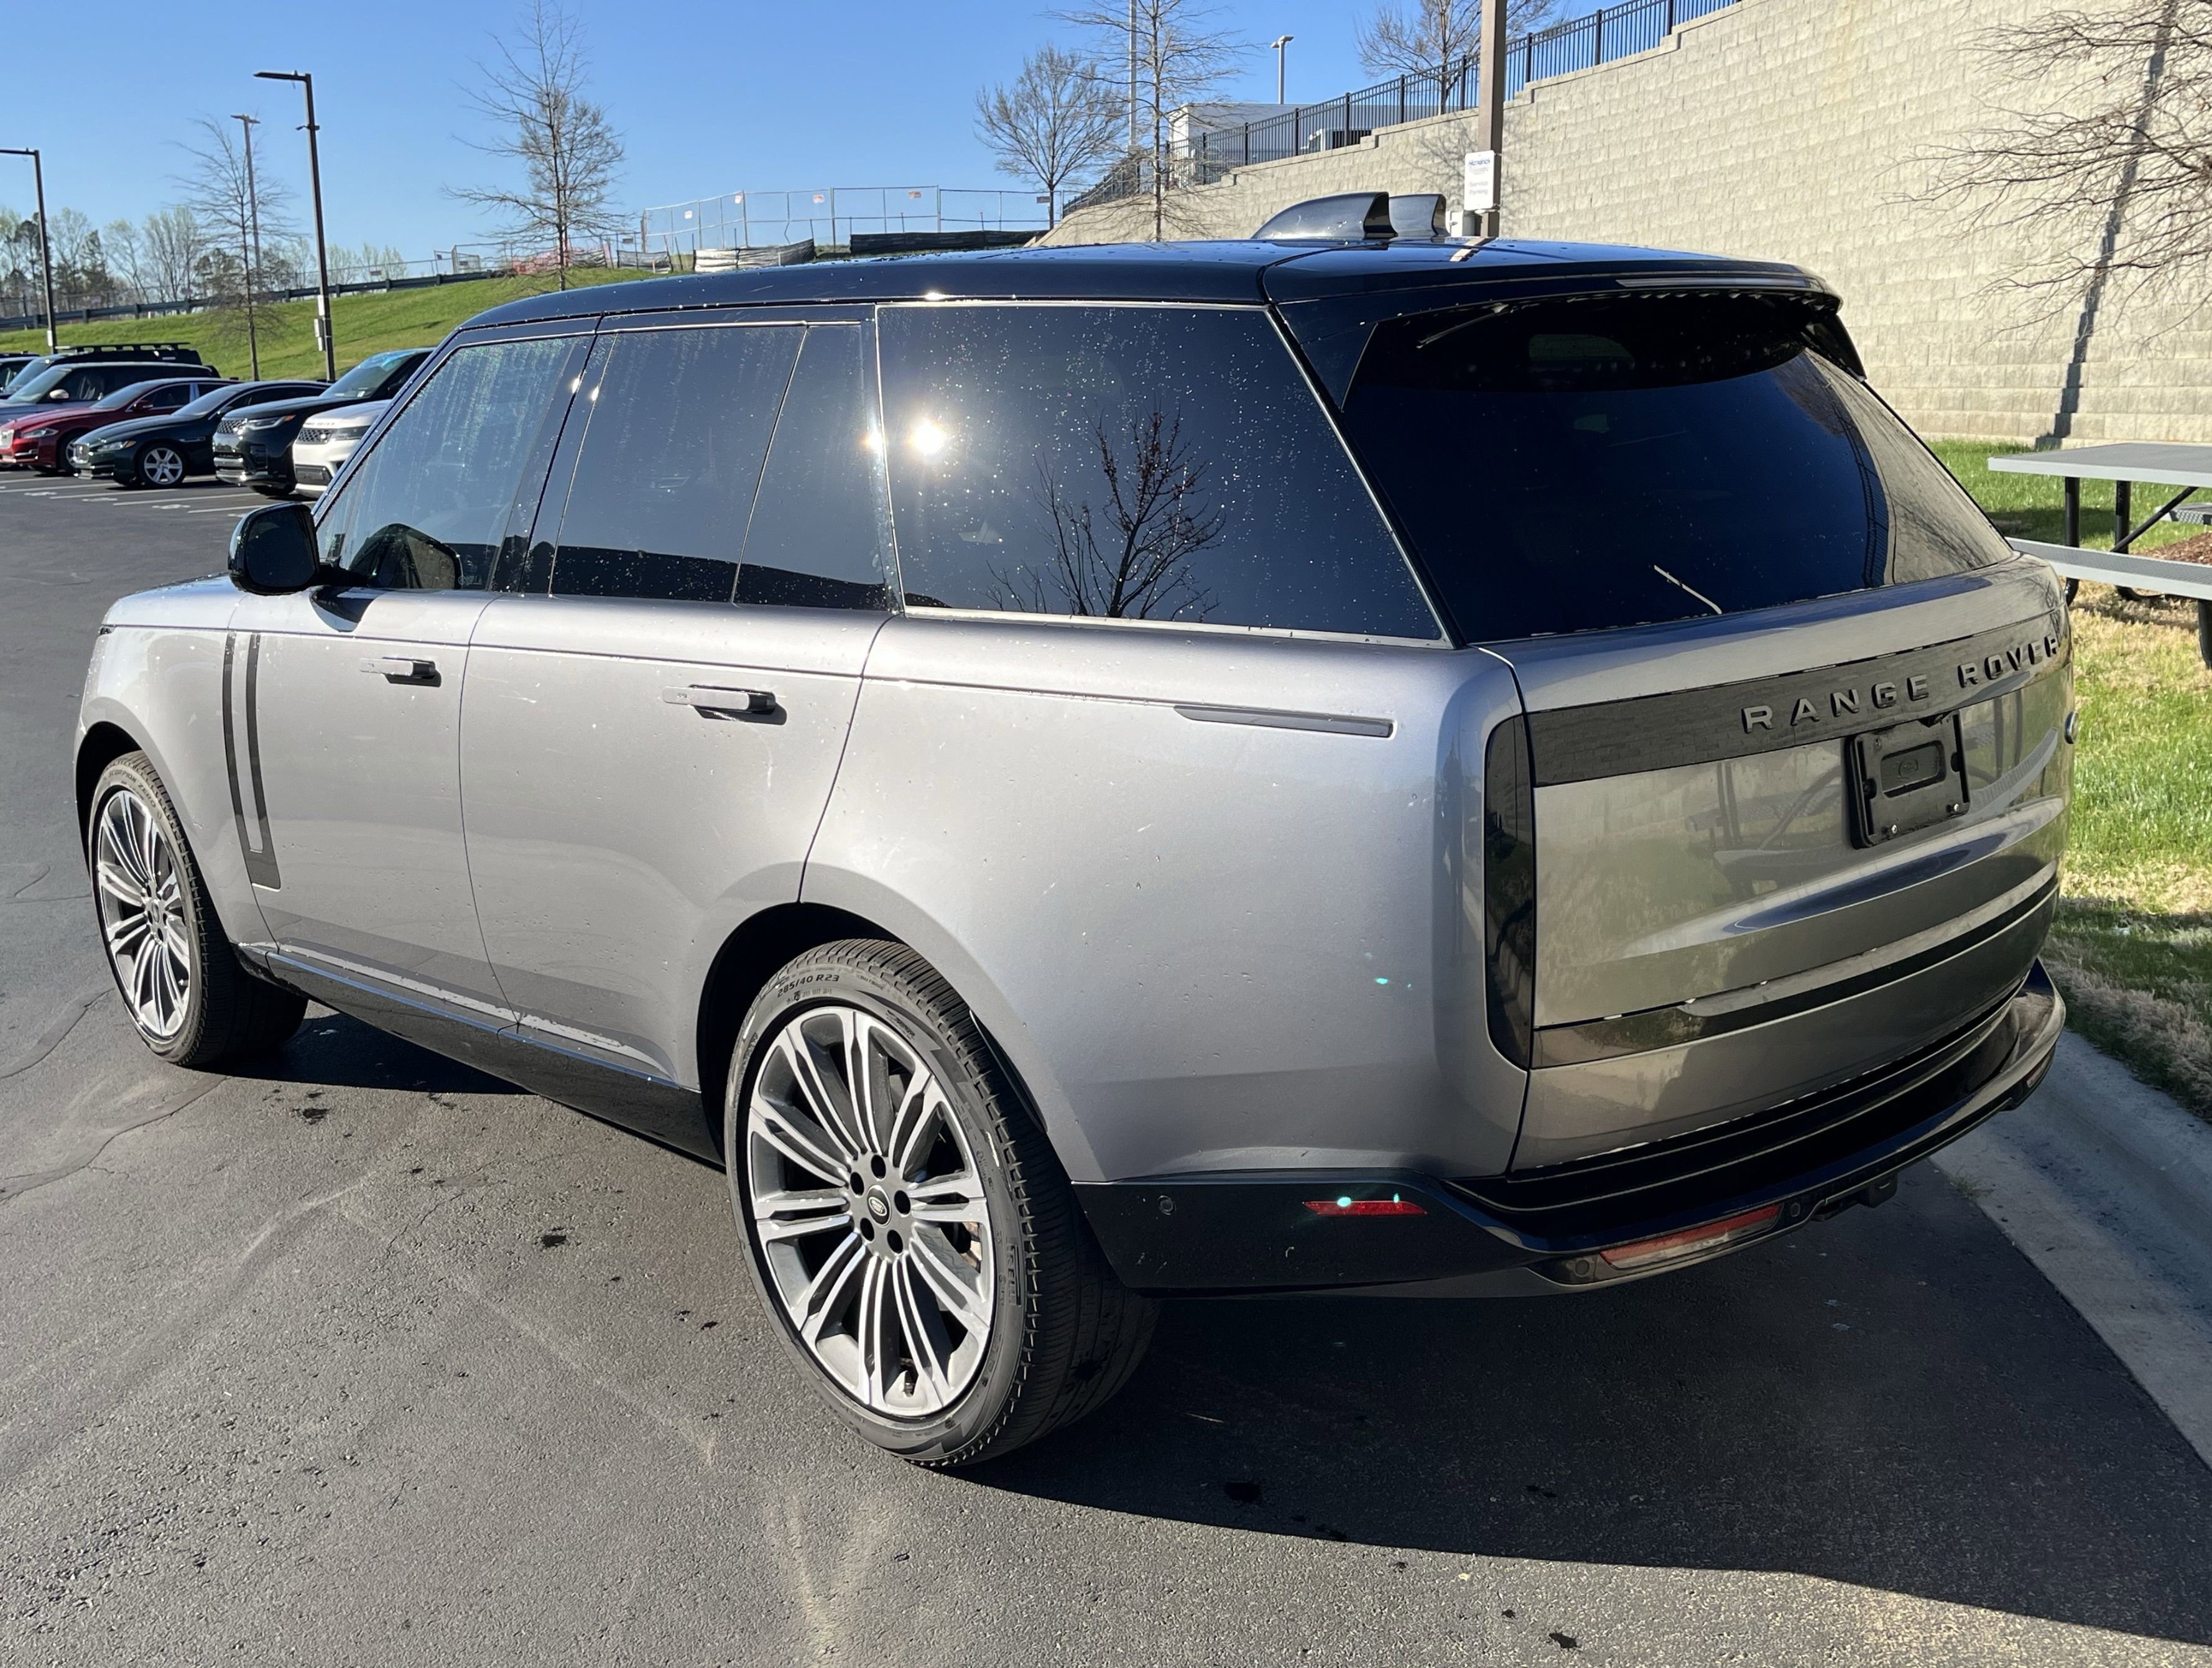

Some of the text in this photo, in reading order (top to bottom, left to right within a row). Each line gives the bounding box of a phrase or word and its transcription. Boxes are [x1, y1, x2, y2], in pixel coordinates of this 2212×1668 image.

[1741, 635, 2058, 734] RANGE ROVER
[778, 975, 813, 998] 285/40
